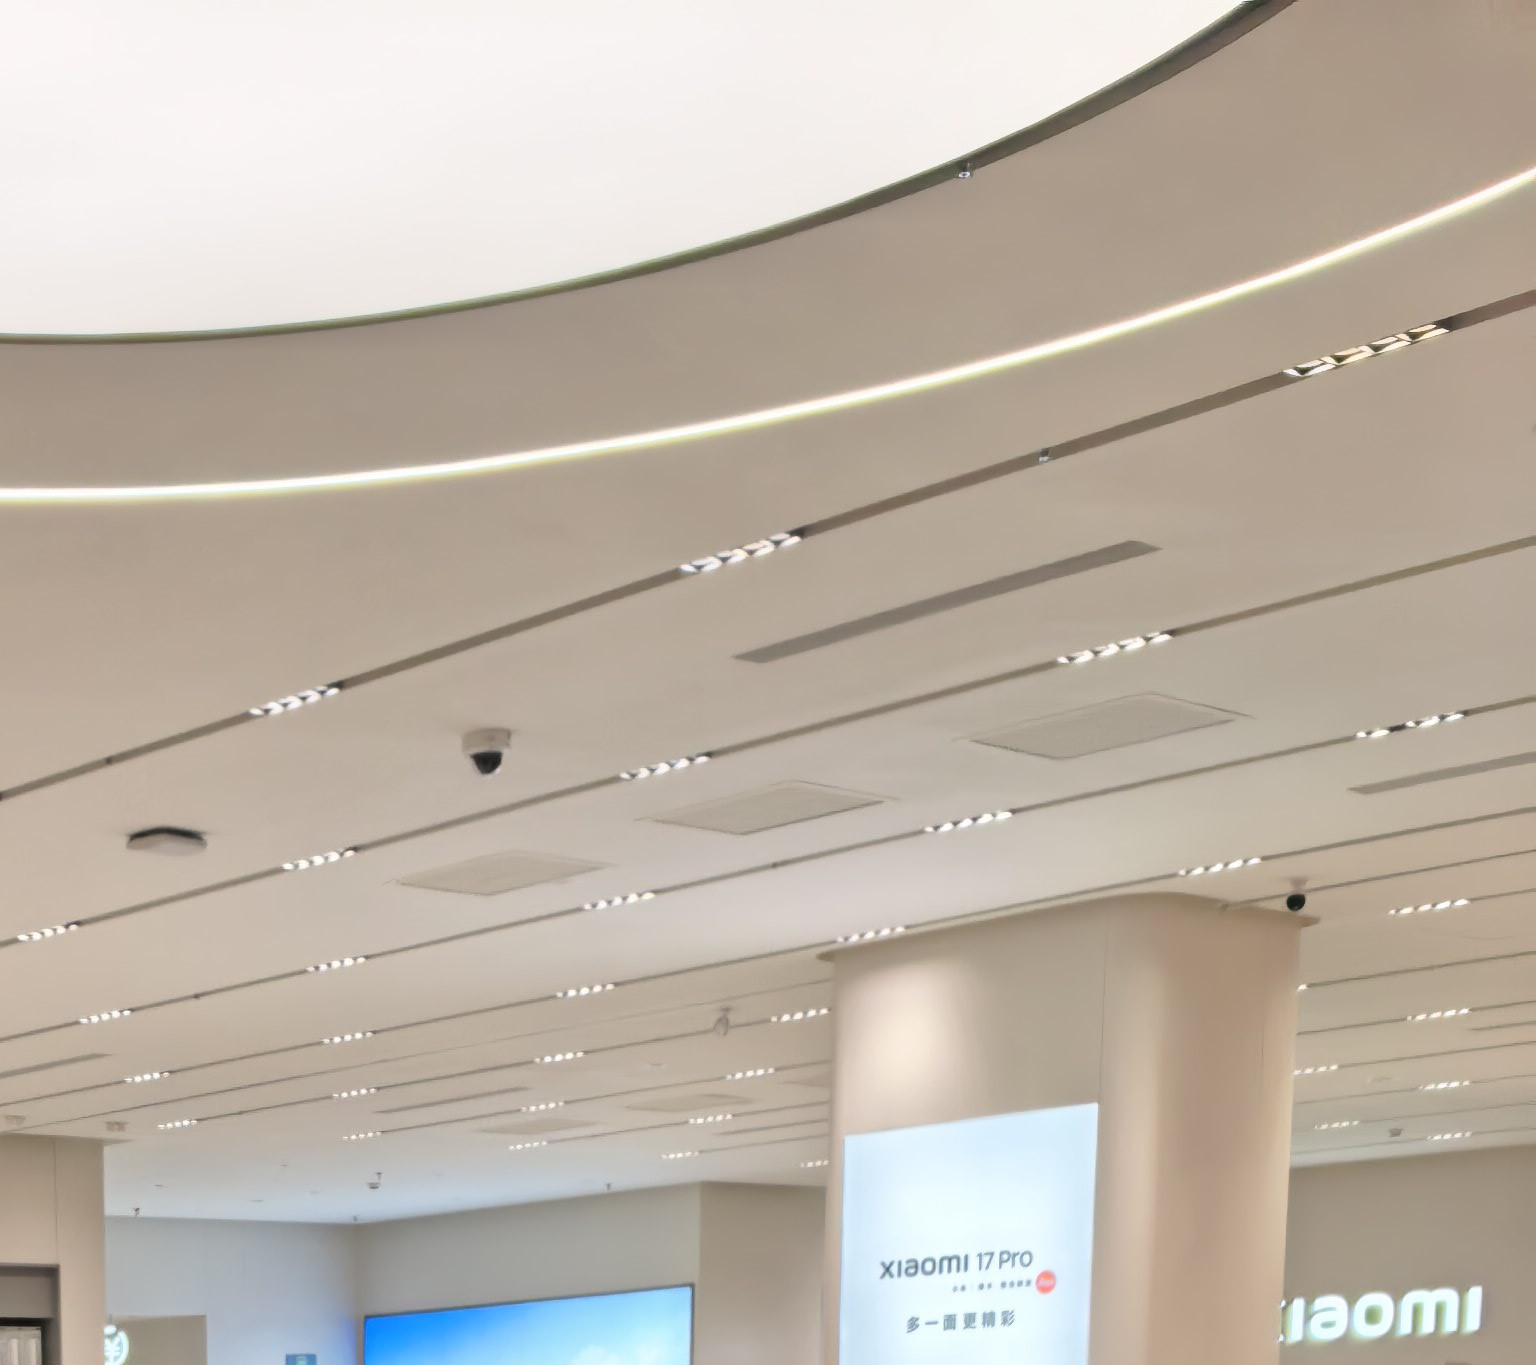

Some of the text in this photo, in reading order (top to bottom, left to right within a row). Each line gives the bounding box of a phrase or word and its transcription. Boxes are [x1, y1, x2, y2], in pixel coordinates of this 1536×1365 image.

[977, 1252, 995, 1271] 17
[998, 1250, 1034, 1269] Pro
[906, 1309, 1015, 1334] 多一面更精彩
[1279, 1285, 1483, 1344] iaomi
